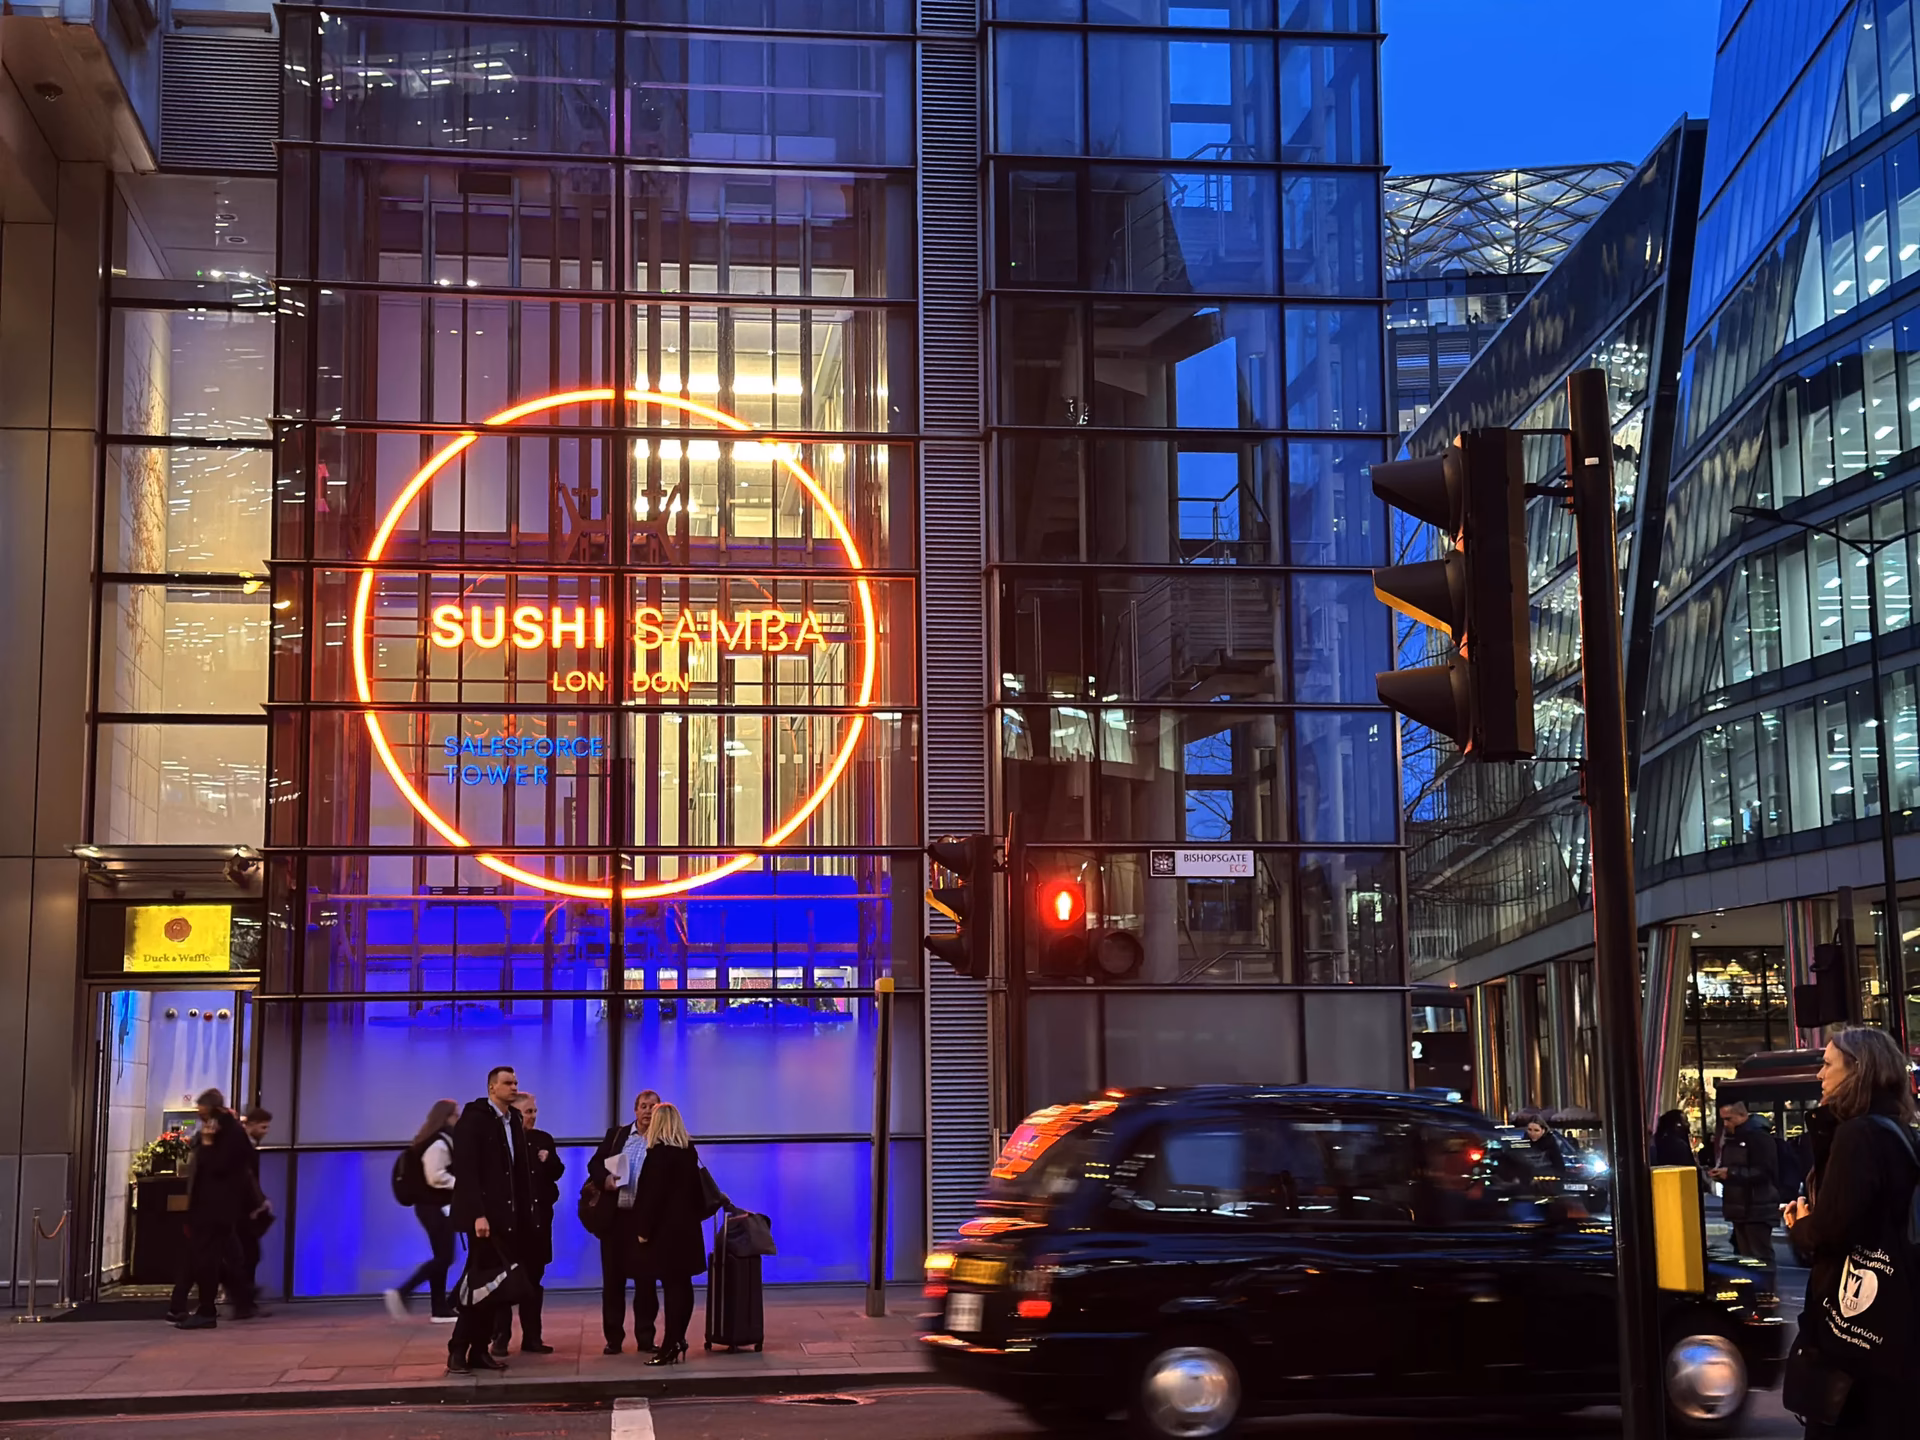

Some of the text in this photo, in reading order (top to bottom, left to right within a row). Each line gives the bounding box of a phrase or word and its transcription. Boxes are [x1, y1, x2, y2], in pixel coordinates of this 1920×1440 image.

[431, 604, 828, 651] SUSHI SAMBA
[553, 671, 689, 693] LON DON
[444, 735, 603, 758] SALESFORCE
[444, 764, 549, 786] TOWER
[1183, 853, 1247, 863] BISHOPSGATE
[1229, 864, 1248, 873] EC2
[143, 953, 170, 963] Duck
[178, 953, 211, 963] Waffle
[1863, 1248, 1891, 1263] media
[1850, 1325, 1884, 1345] union!
